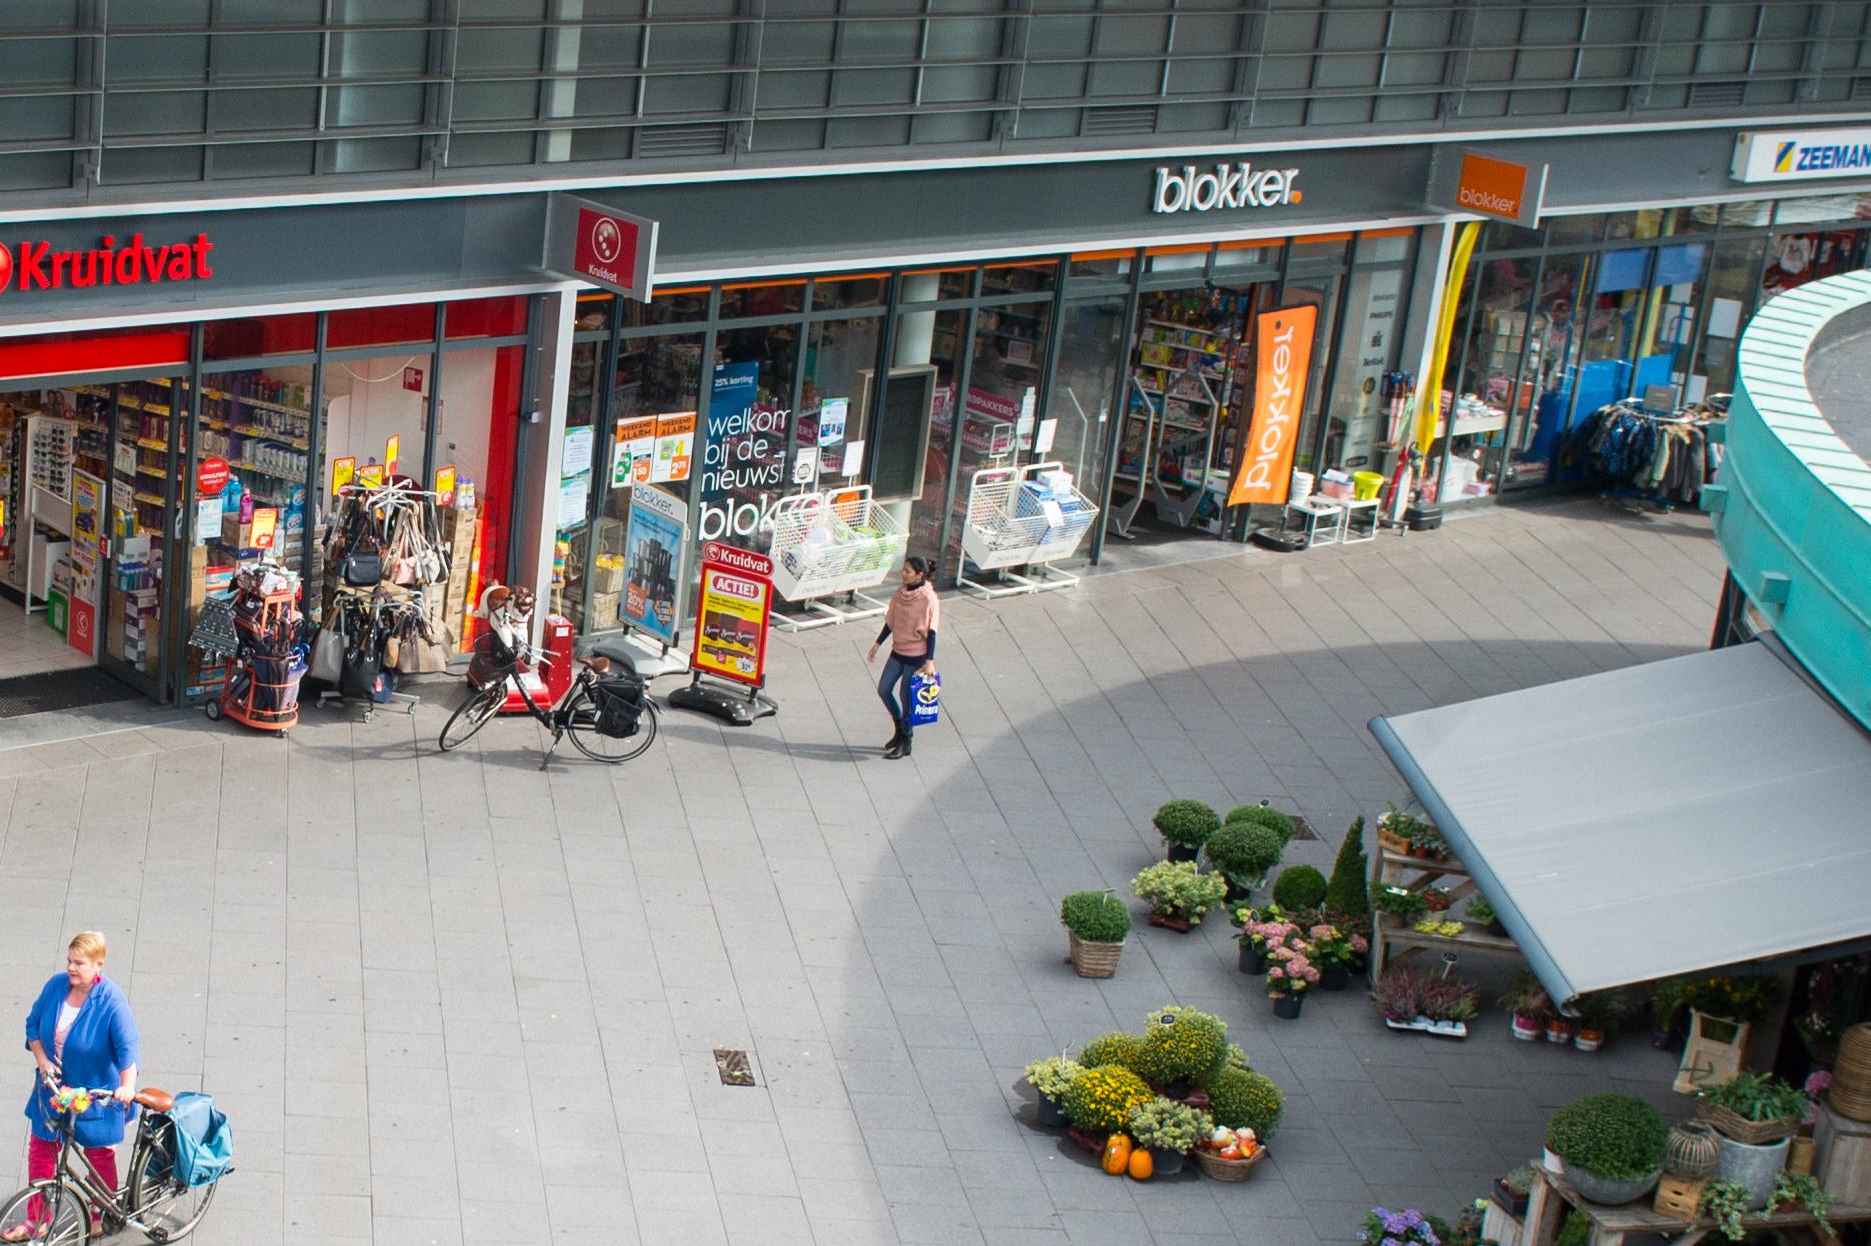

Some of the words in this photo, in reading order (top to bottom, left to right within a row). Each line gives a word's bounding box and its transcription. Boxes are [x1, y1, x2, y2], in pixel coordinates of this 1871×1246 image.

[1796, 144, 1871, 171] ZEEMAN
[18, 232, 214, 291] Kruidvat
[588, 263, 617, 283] Kruidvat
[621, 429, 651, 440] ALARM
[662, 425, 691, 436] ALARM
[705, 436, 730, 470] bij
[737, 435, 768, 461] de
[702, 463, 789, 493] nieuwst
[720, 549, 769, 573] Kruidvat
[716, 577, 755, 597] ACTIE!
